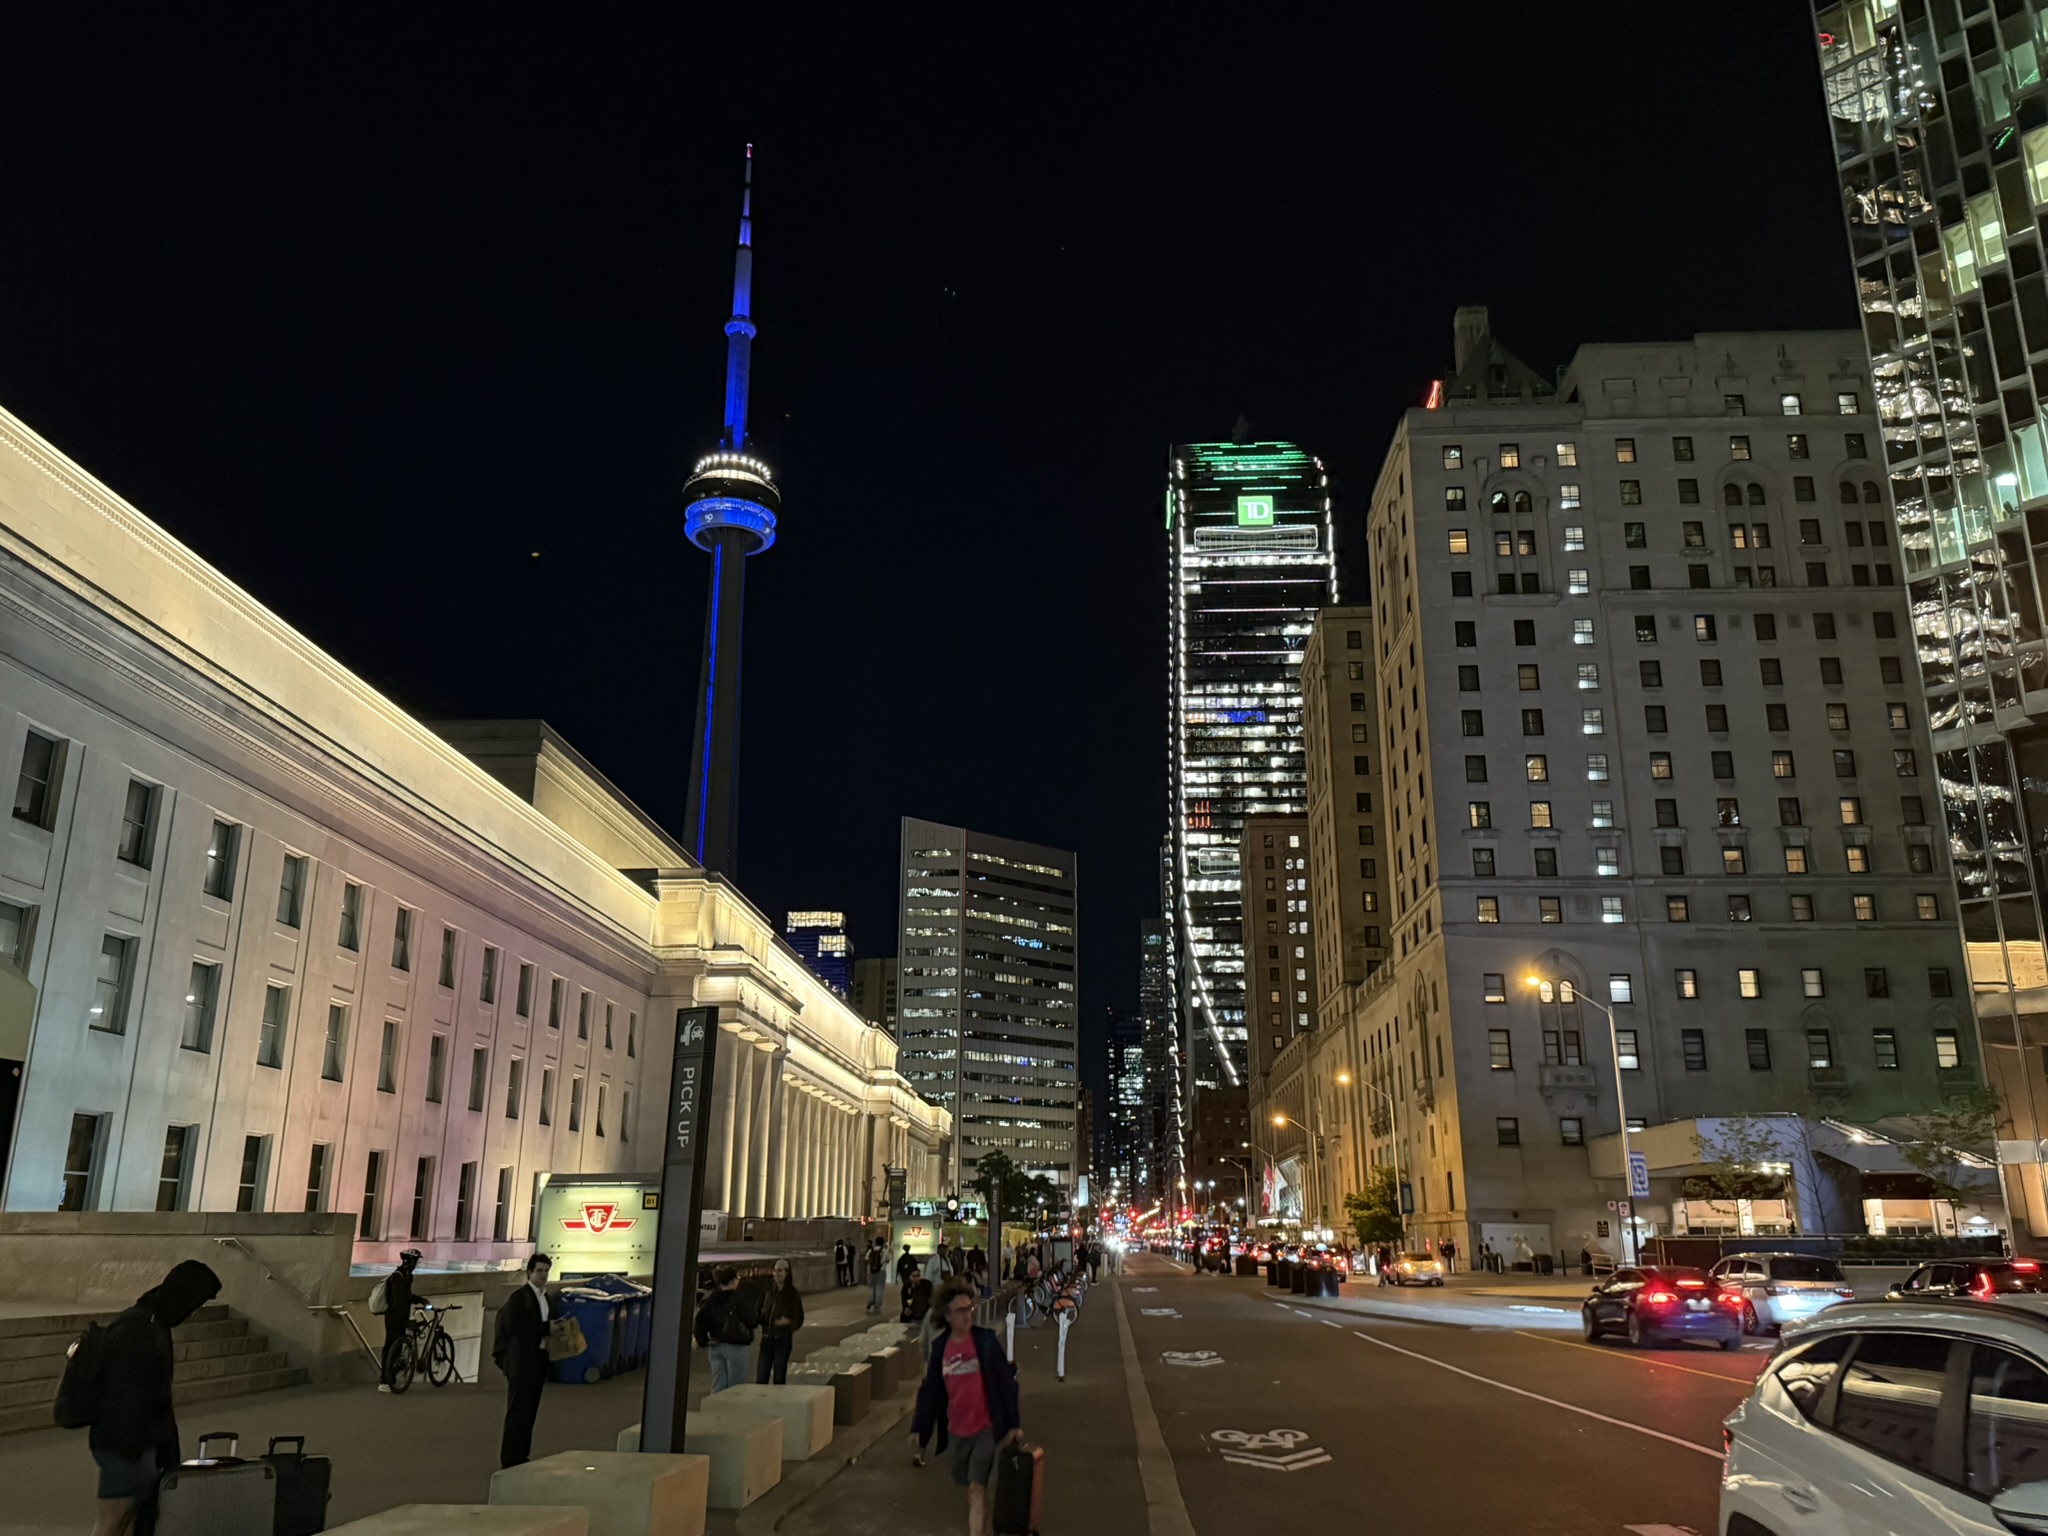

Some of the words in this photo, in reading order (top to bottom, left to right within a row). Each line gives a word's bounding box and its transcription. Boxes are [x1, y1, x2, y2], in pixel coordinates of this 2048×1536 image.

[1241, 501, 1270, 520] TD
[679, 1067, 695, 1114] PICK
[677, 1120, 691, 1148] UP
